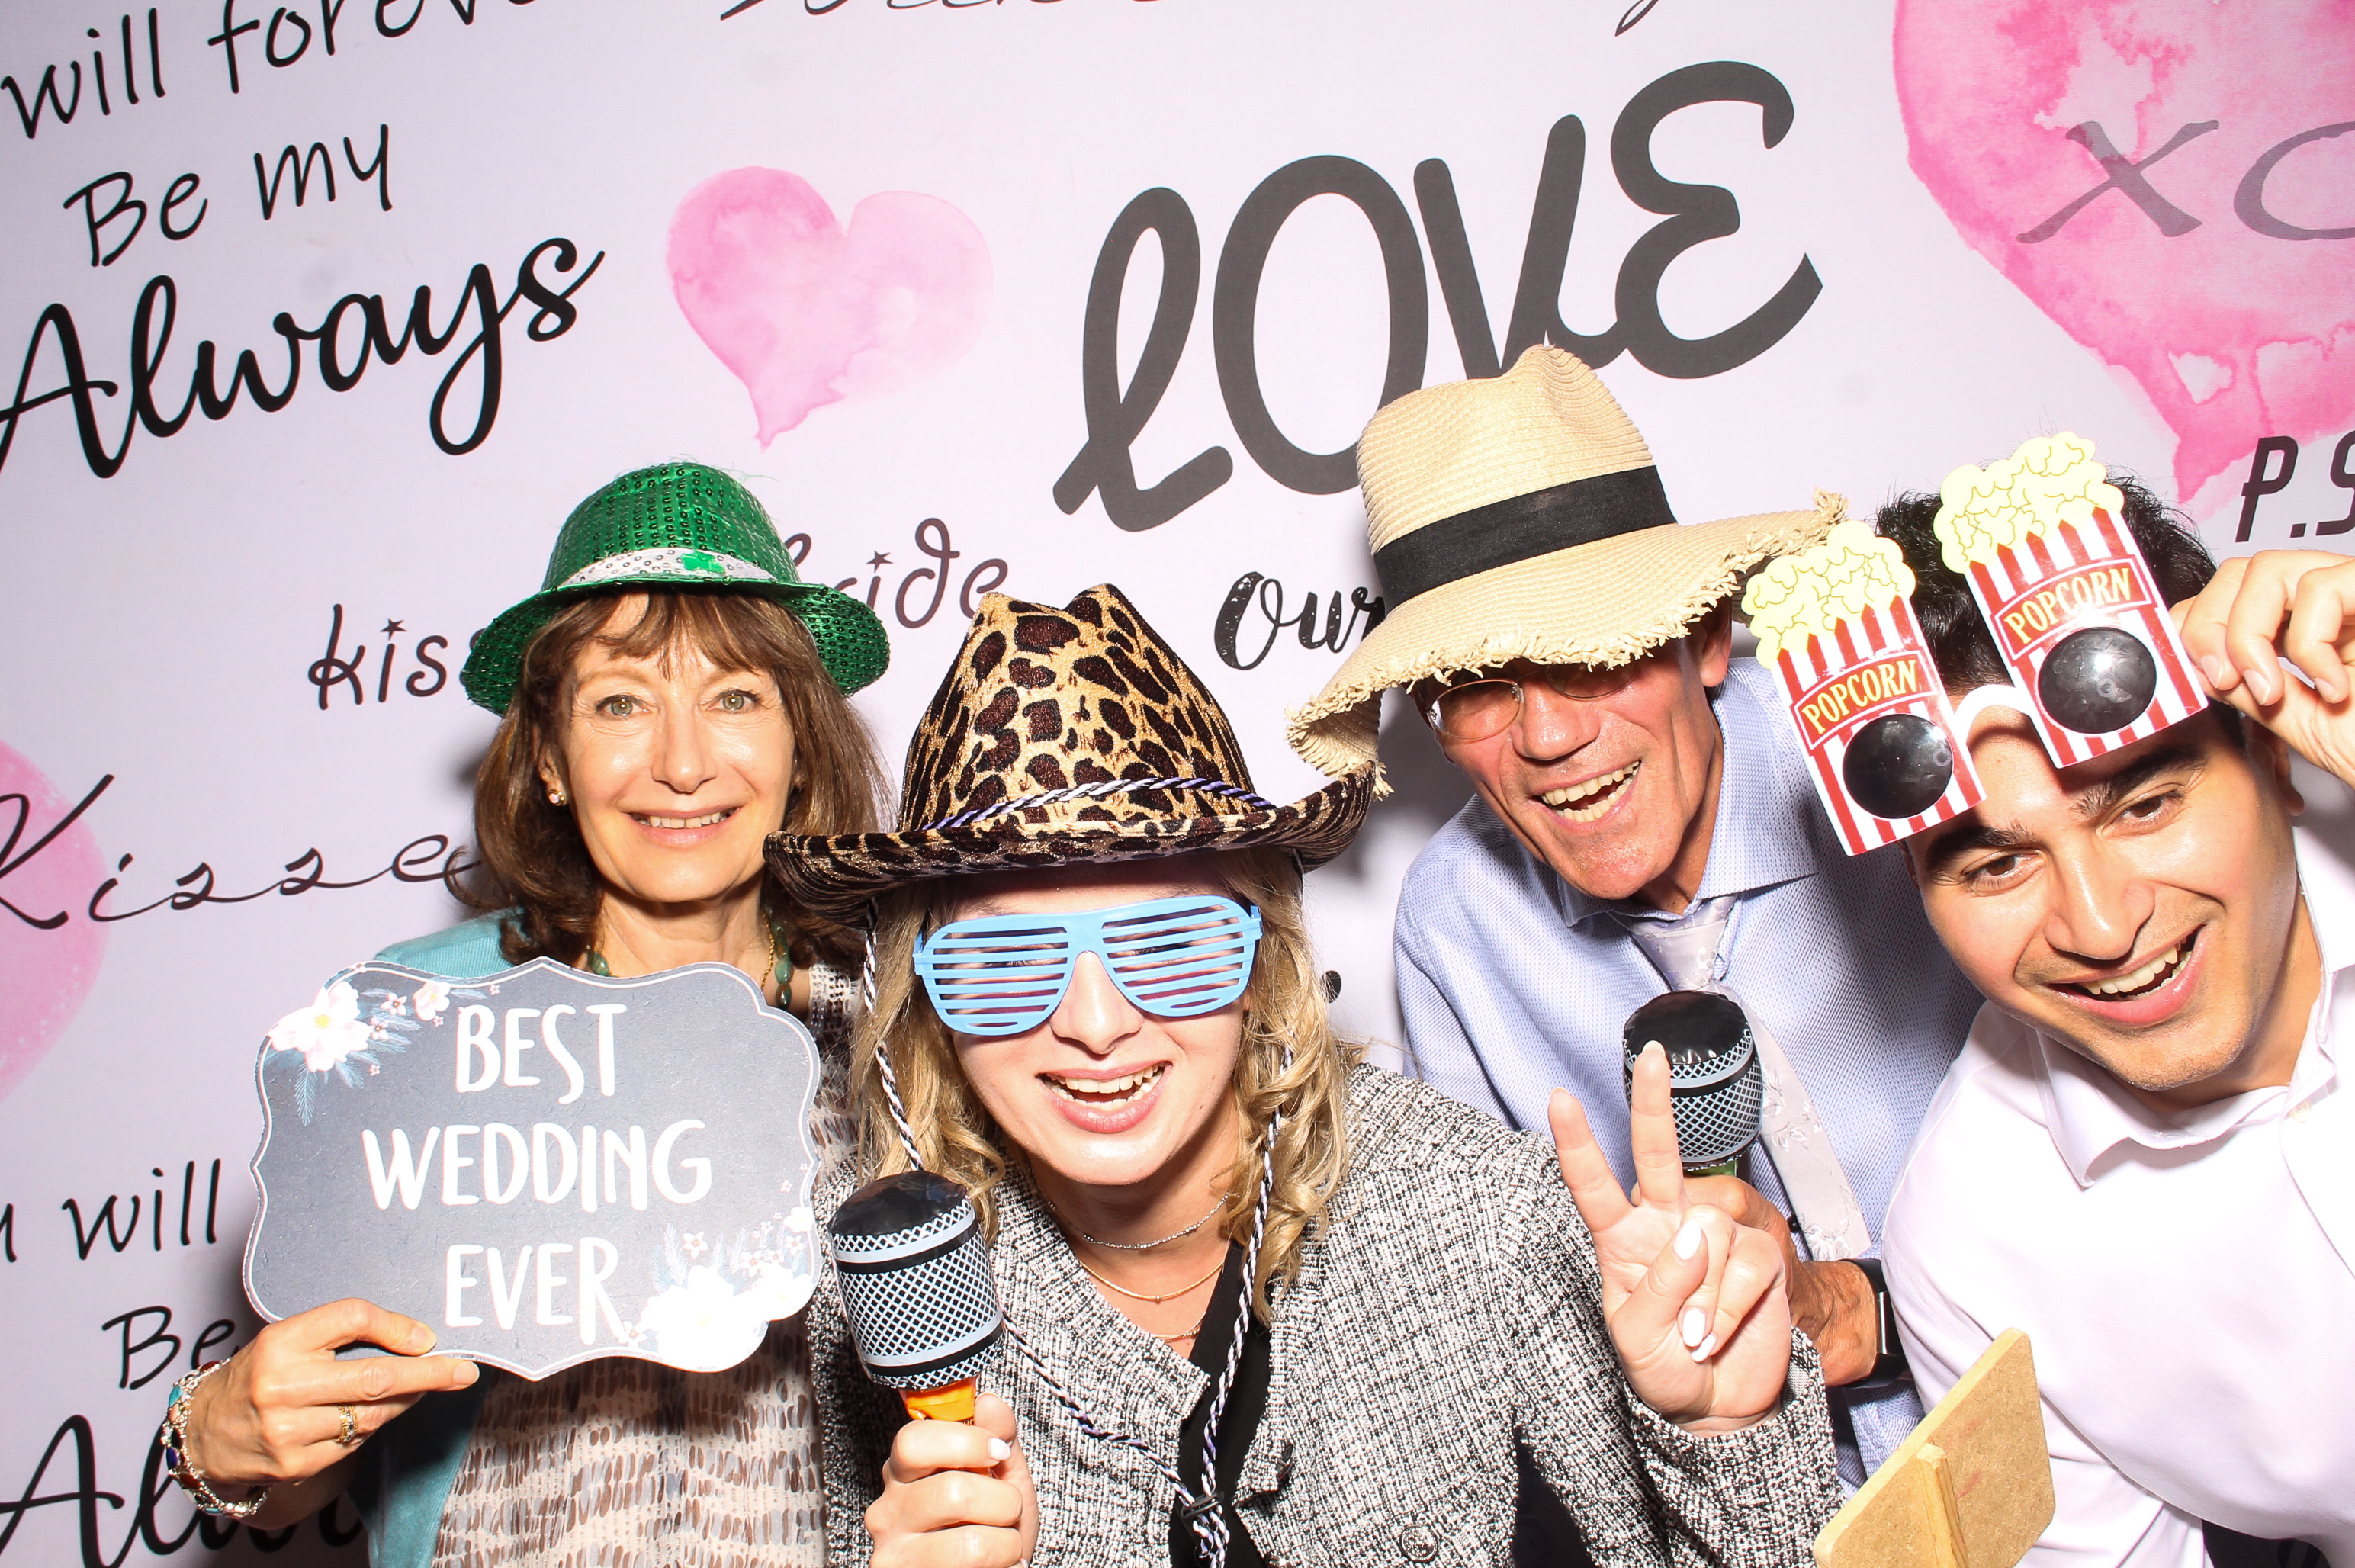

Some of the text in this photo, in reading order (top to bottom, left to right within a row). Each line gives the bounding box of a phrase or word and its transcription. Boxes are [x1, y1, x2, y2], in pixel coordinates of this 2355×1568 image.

[1, 7, 165, 139] will
[63, 124, 392, 267] Be my
[0, 237, 605, 478] Always
[2004, 567, 2131, 644] POPCORN
[1801, 659, 1916, 734] POPCORN
[457, 1002, 628, 1105] BEST
[62, 1158, 221, 1260] will
[361, 1118, 713, 1213] WEDDING
[444, 1236, 630, 1346] EVER
